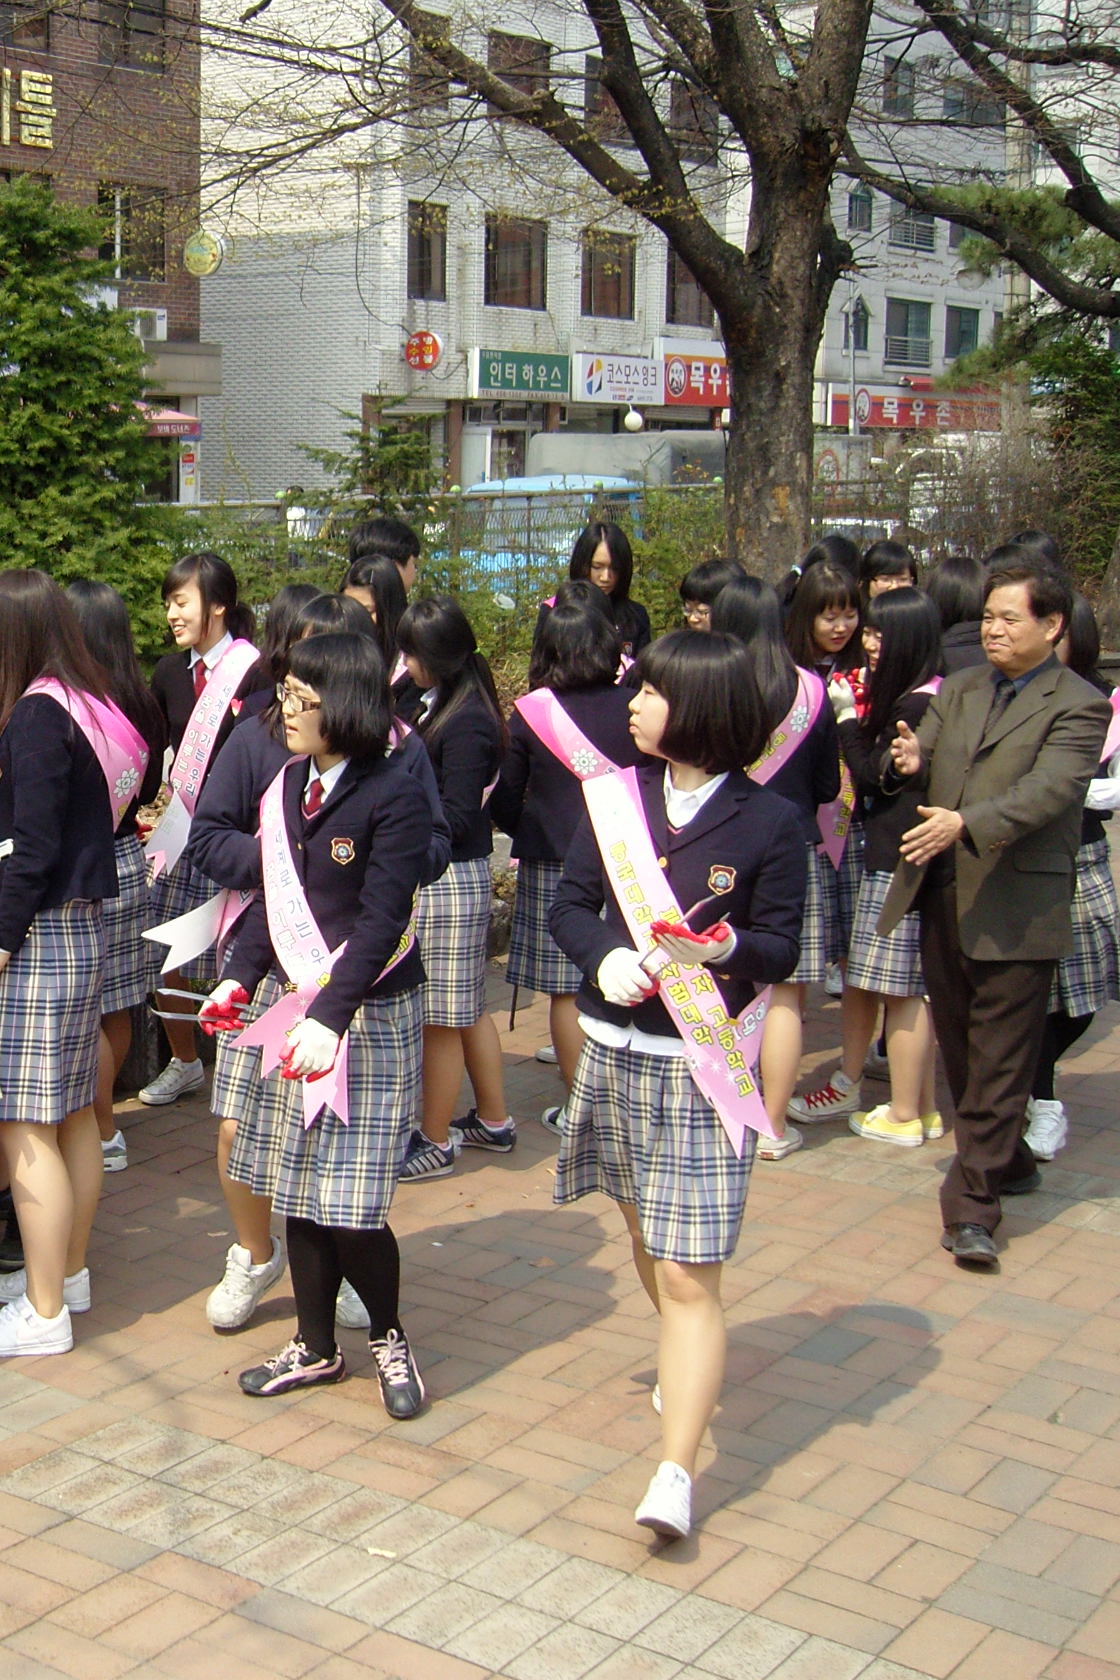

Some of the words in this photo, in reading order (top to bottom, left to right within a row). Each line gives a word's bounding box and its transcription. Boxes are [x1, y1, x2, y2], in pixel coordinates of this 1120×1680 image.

[691, 361, 729, 397] 목우
[882, 397, 950, 426] 목우촌
[707, 1003, 755, 1099] 고등학교
